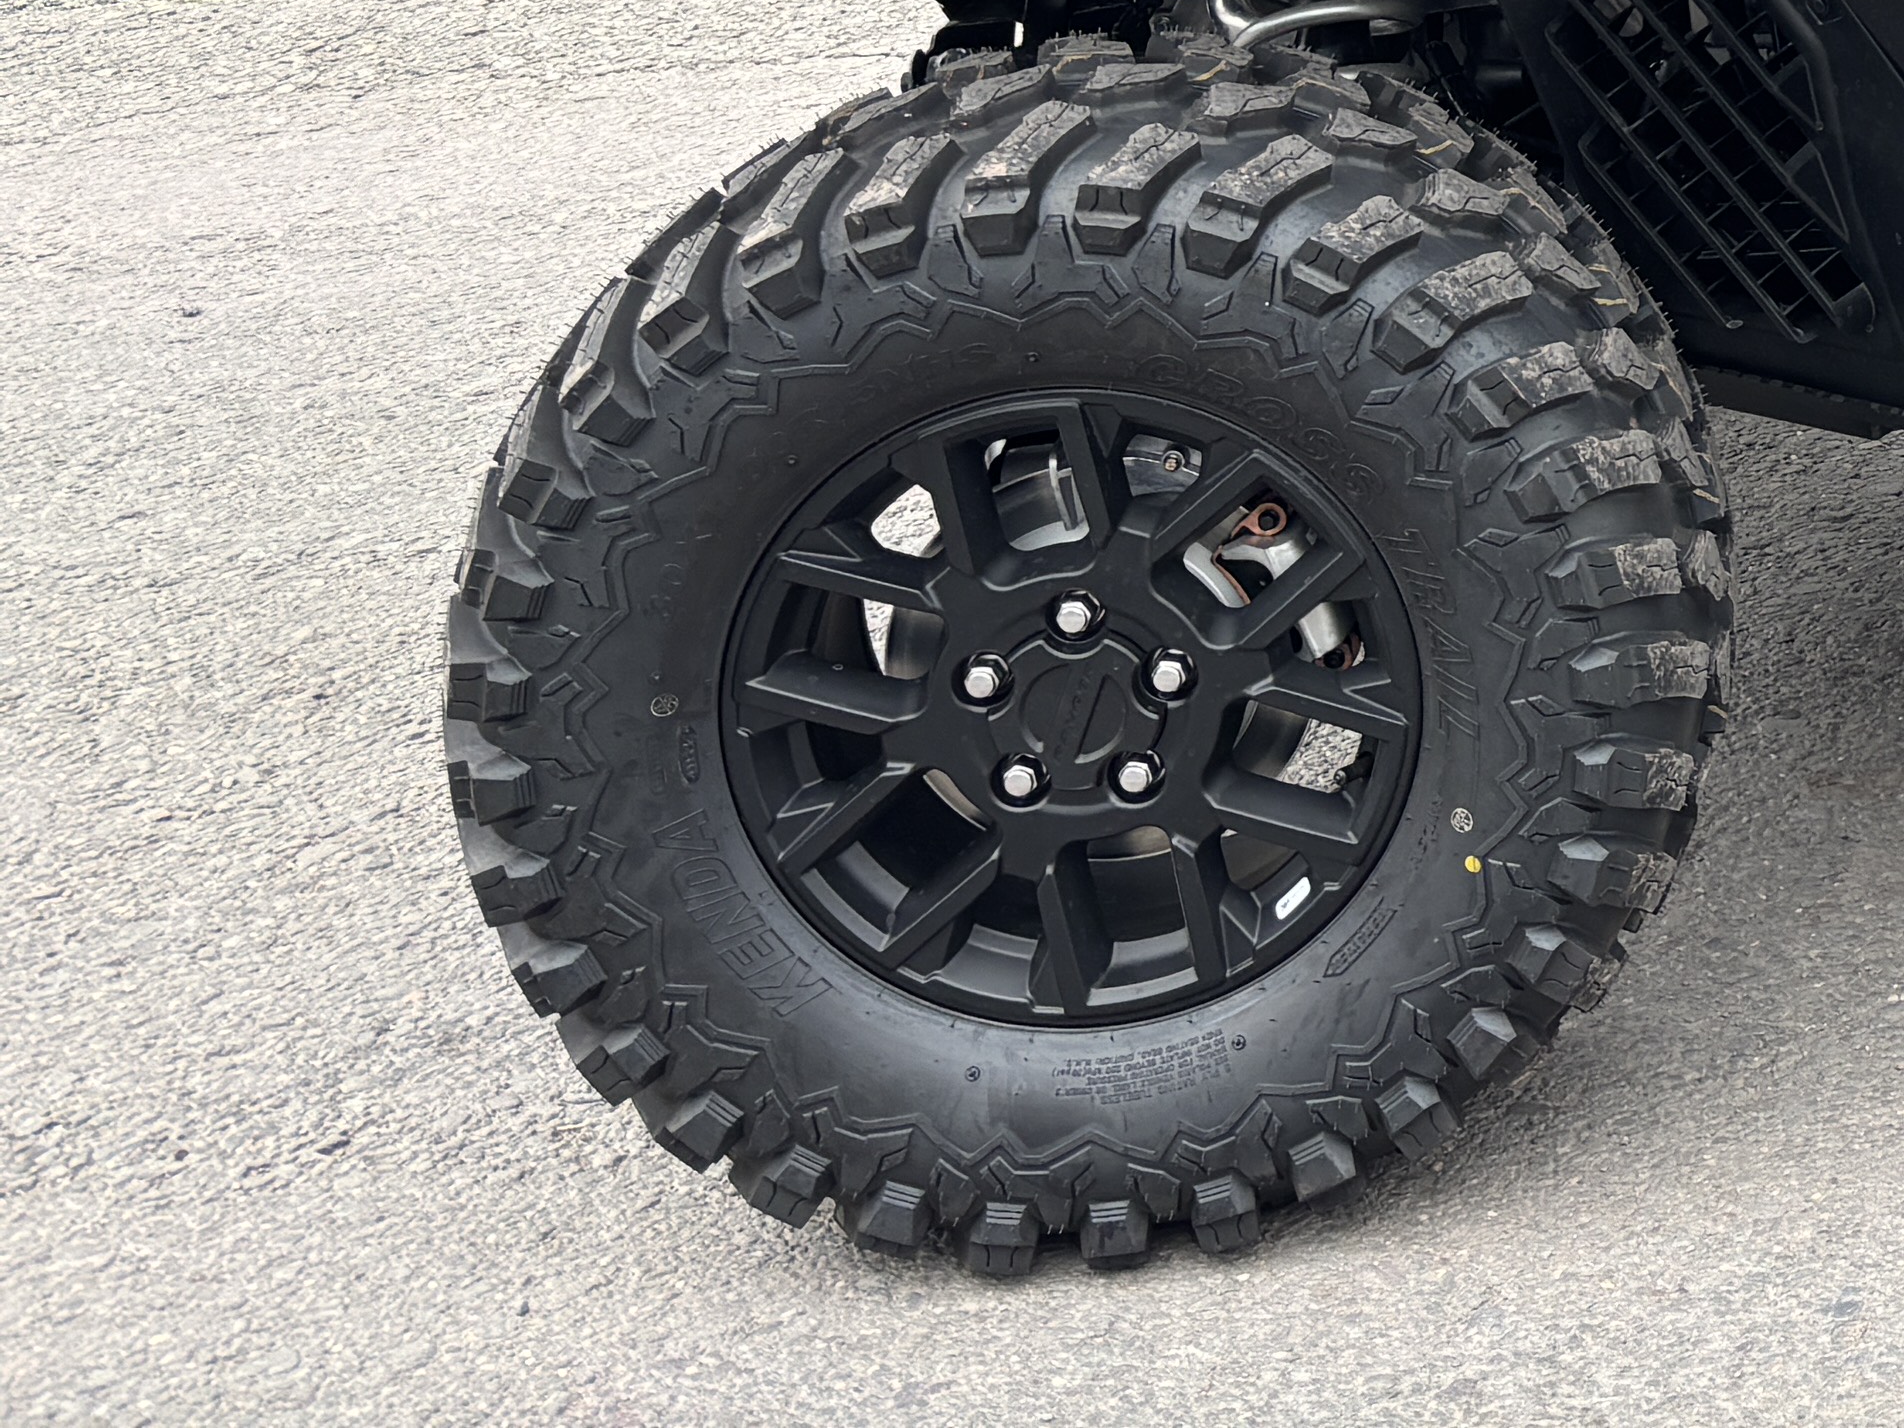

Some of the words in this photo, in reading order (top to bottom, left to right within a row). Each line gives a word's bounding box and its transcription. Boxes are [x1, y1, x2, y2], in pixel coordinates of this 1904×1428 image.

[1134, 353, 1386, 506] CROSS
[1374, 526, 1481, 740] TRAIL
[652, 808, 834, 1017] KENDA
